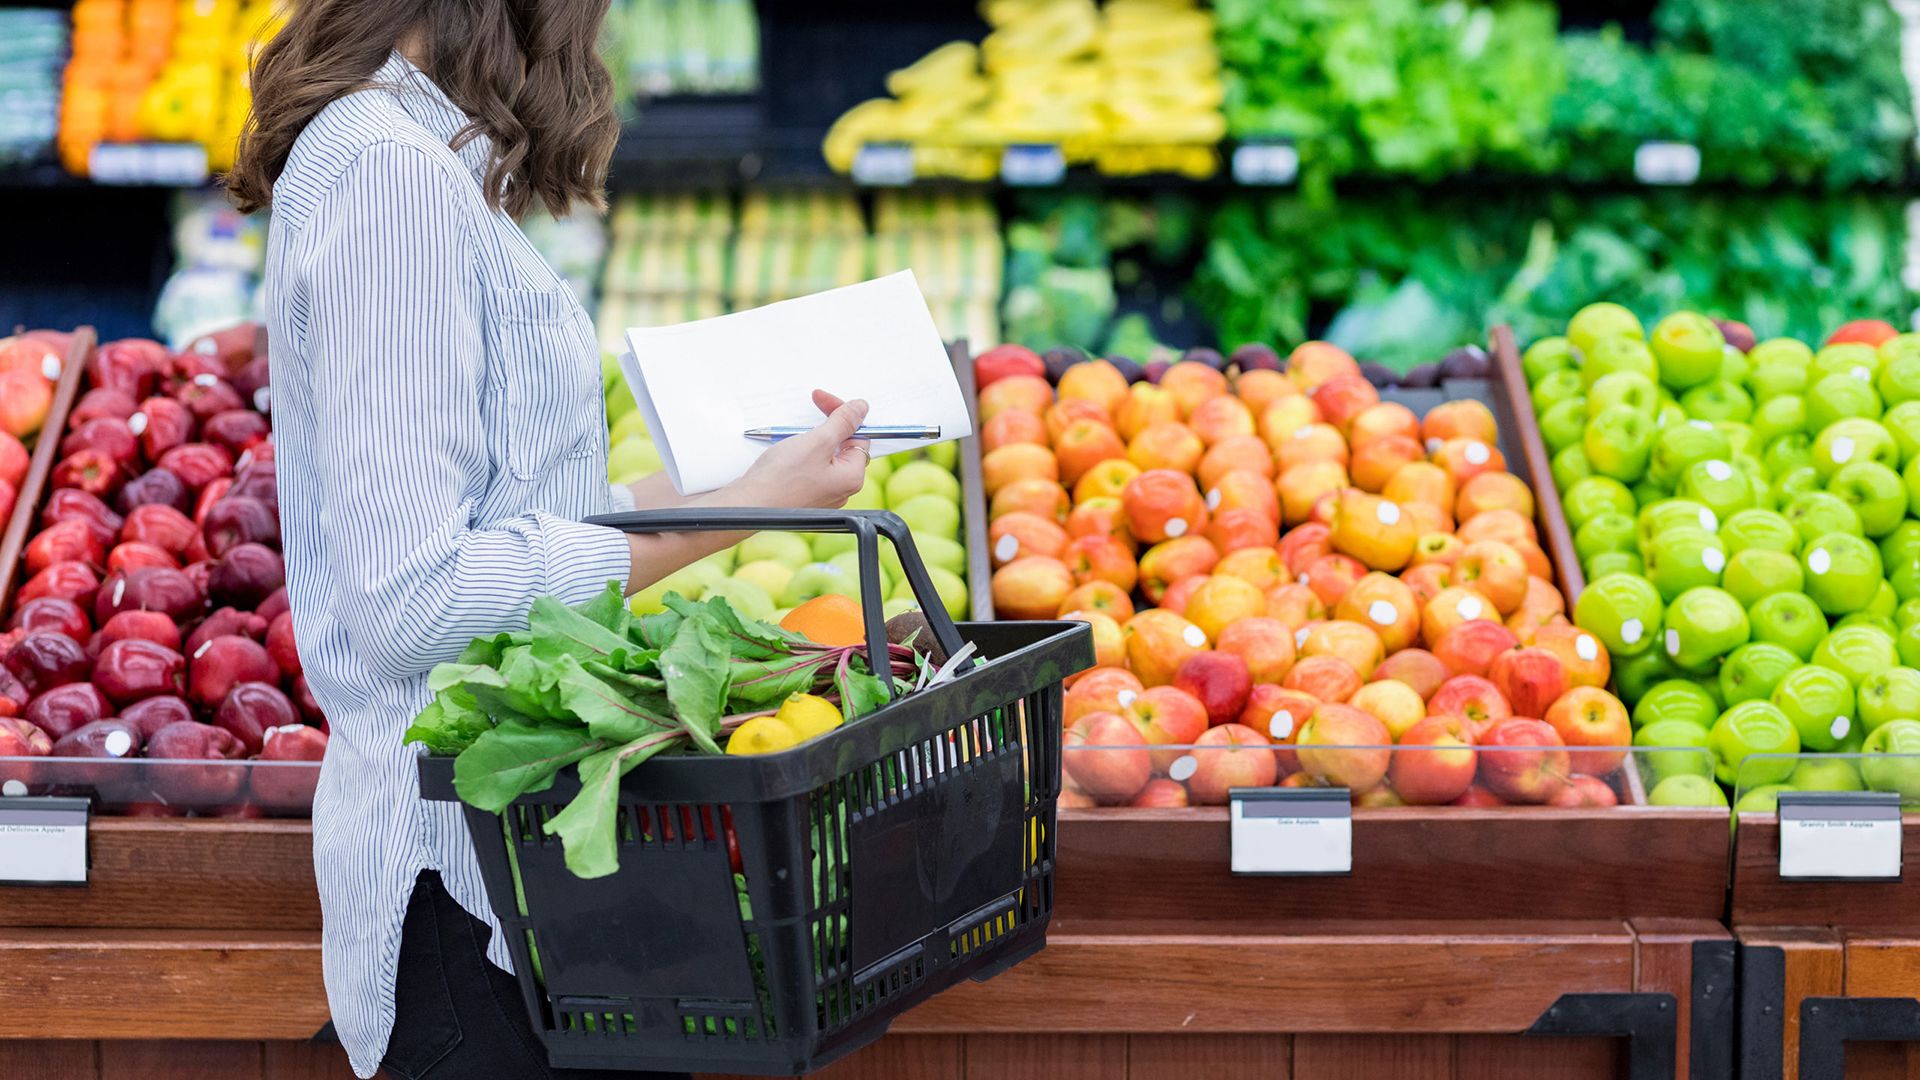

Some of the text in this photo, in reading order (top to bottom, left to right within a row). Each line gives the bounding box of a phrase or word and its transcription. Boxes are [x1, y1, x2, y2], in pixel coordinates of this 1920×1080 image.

[1800, 820, 1873, 829] Granny Smith Apples
[41, 826, 65, 834] Apples
